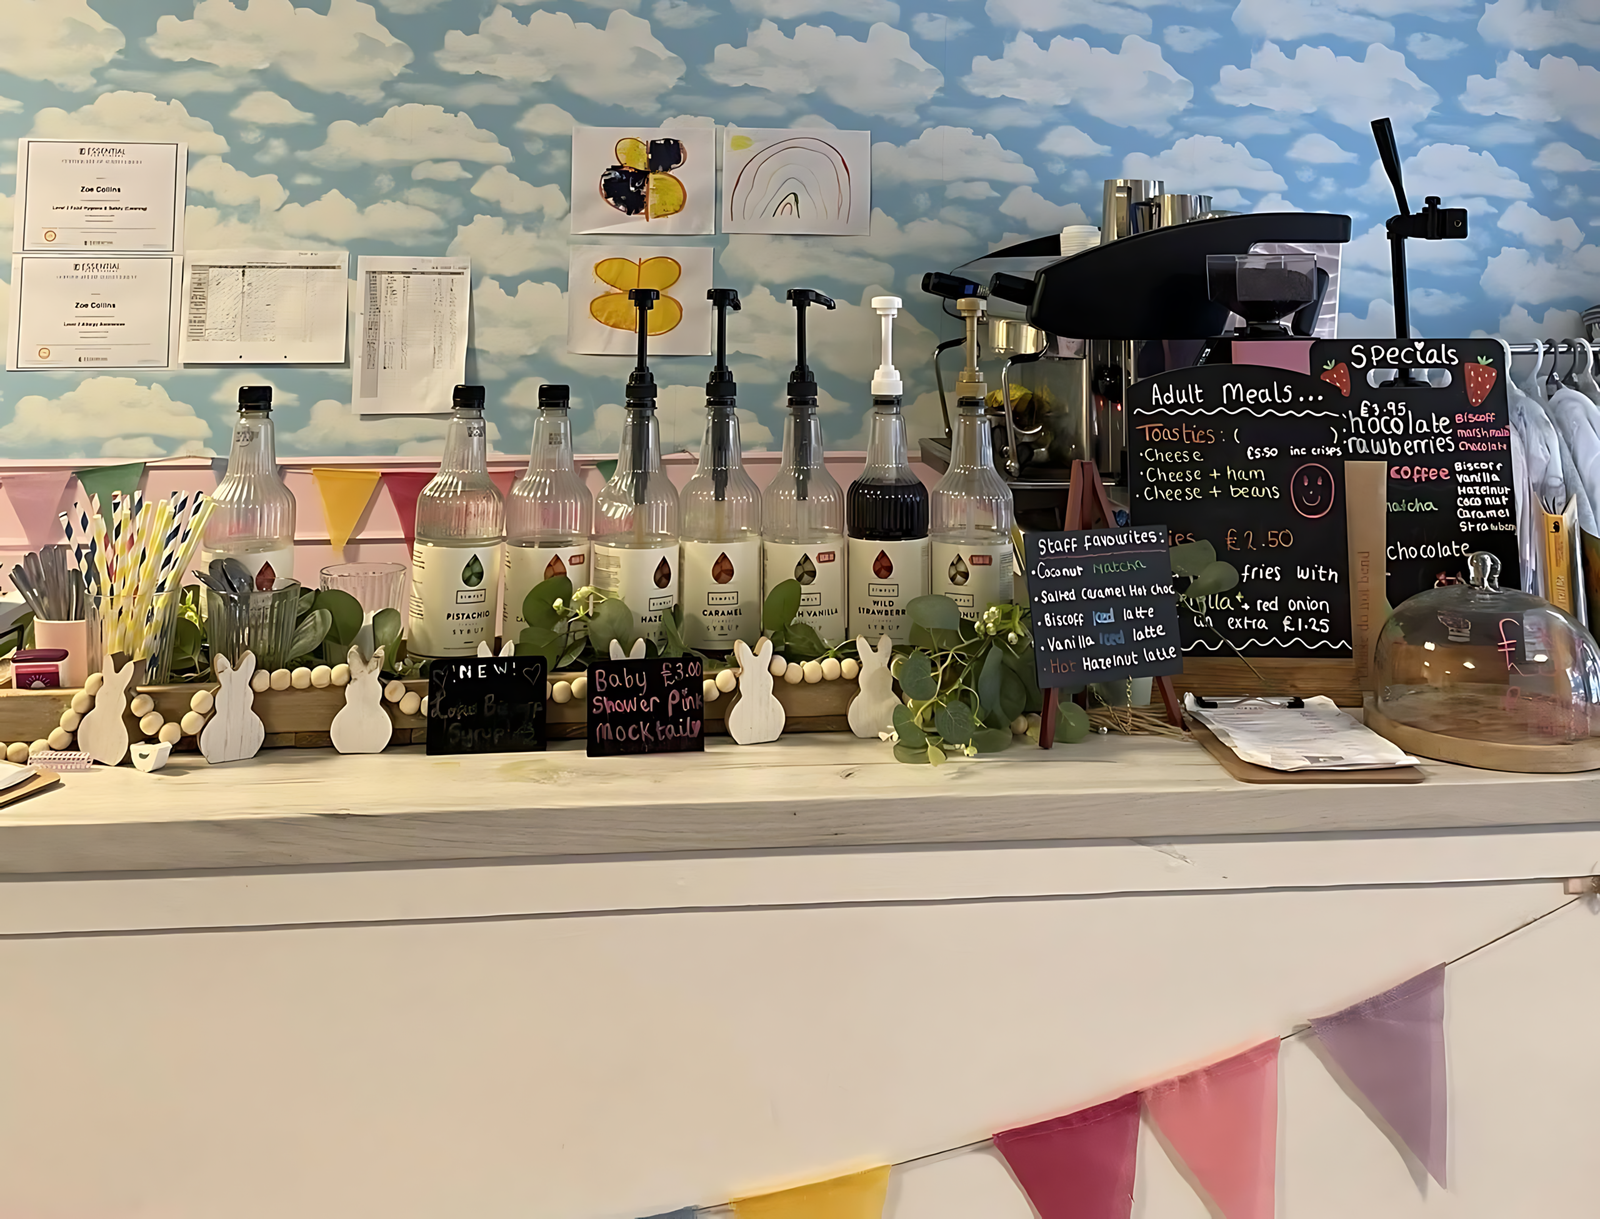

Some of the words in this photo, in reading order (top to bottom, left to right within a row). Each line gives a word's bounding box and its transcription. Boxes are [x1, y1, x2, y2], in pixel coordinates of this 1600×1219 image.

[1350, 341, 1460, 369] Specials
[1151, 382, 1205, 406] Adult
[1360, 400, 1407, 418] £3.95
[1342, 409, 1453, 435] hocolate
[1289, 445, 1307, 456] inc
[1311, 445, 1343, 457] crisps
[1343, 435, 1456, 456] rawberries
[1144, 447, 1204, 463] Cheese
[1145, 466, 1202, 483] Cheese
[1226, 465, 1266, 482] ham
[1143, 483, 1203, 502] Cheese
[1229, 484, 1281, 500] beans
[1457, 485, 1512, 496] Hazelnut
[1038, 536, 1079, 556] Staff
[1036, 561, 1084, 579] Coconut
[1241, 563, 1282, 583] fries
[1296, 564, 1339, 584] with
[1040, 588, 1078, 605] Salted
[1128, 584, 1148, 597] Hot
[701, 608, 743, 617] CARAMEL
[806, 607, 839, 618] VANILLA
[858, 606, 906, 617] STRAWBERR
[872, 600, 895, 608] WILD
[1256, 595, 1279, 612] red
[1287, 595, 1330, 614] onion
[446, 610, 490, 621] PISTACHIO
[641, 614, 663, 623] HAZE
[1043, 611, 1085, 628] Biscoff
[1122, 605, 1155, 621] latte
[1227, 615, 1269, 631] extra
[1282, 615, 1330, 633] £1.25
[1046, 634, 1096, 652] Vanilla
[1132, 623, 1167, 642] latte
[1082, 651, 1140, 672] Hazelnut
[1142, 645, 1178, 663] latte
[594, 666, 648, 697] Baby
[660, 660, 703, 688] £3.00
